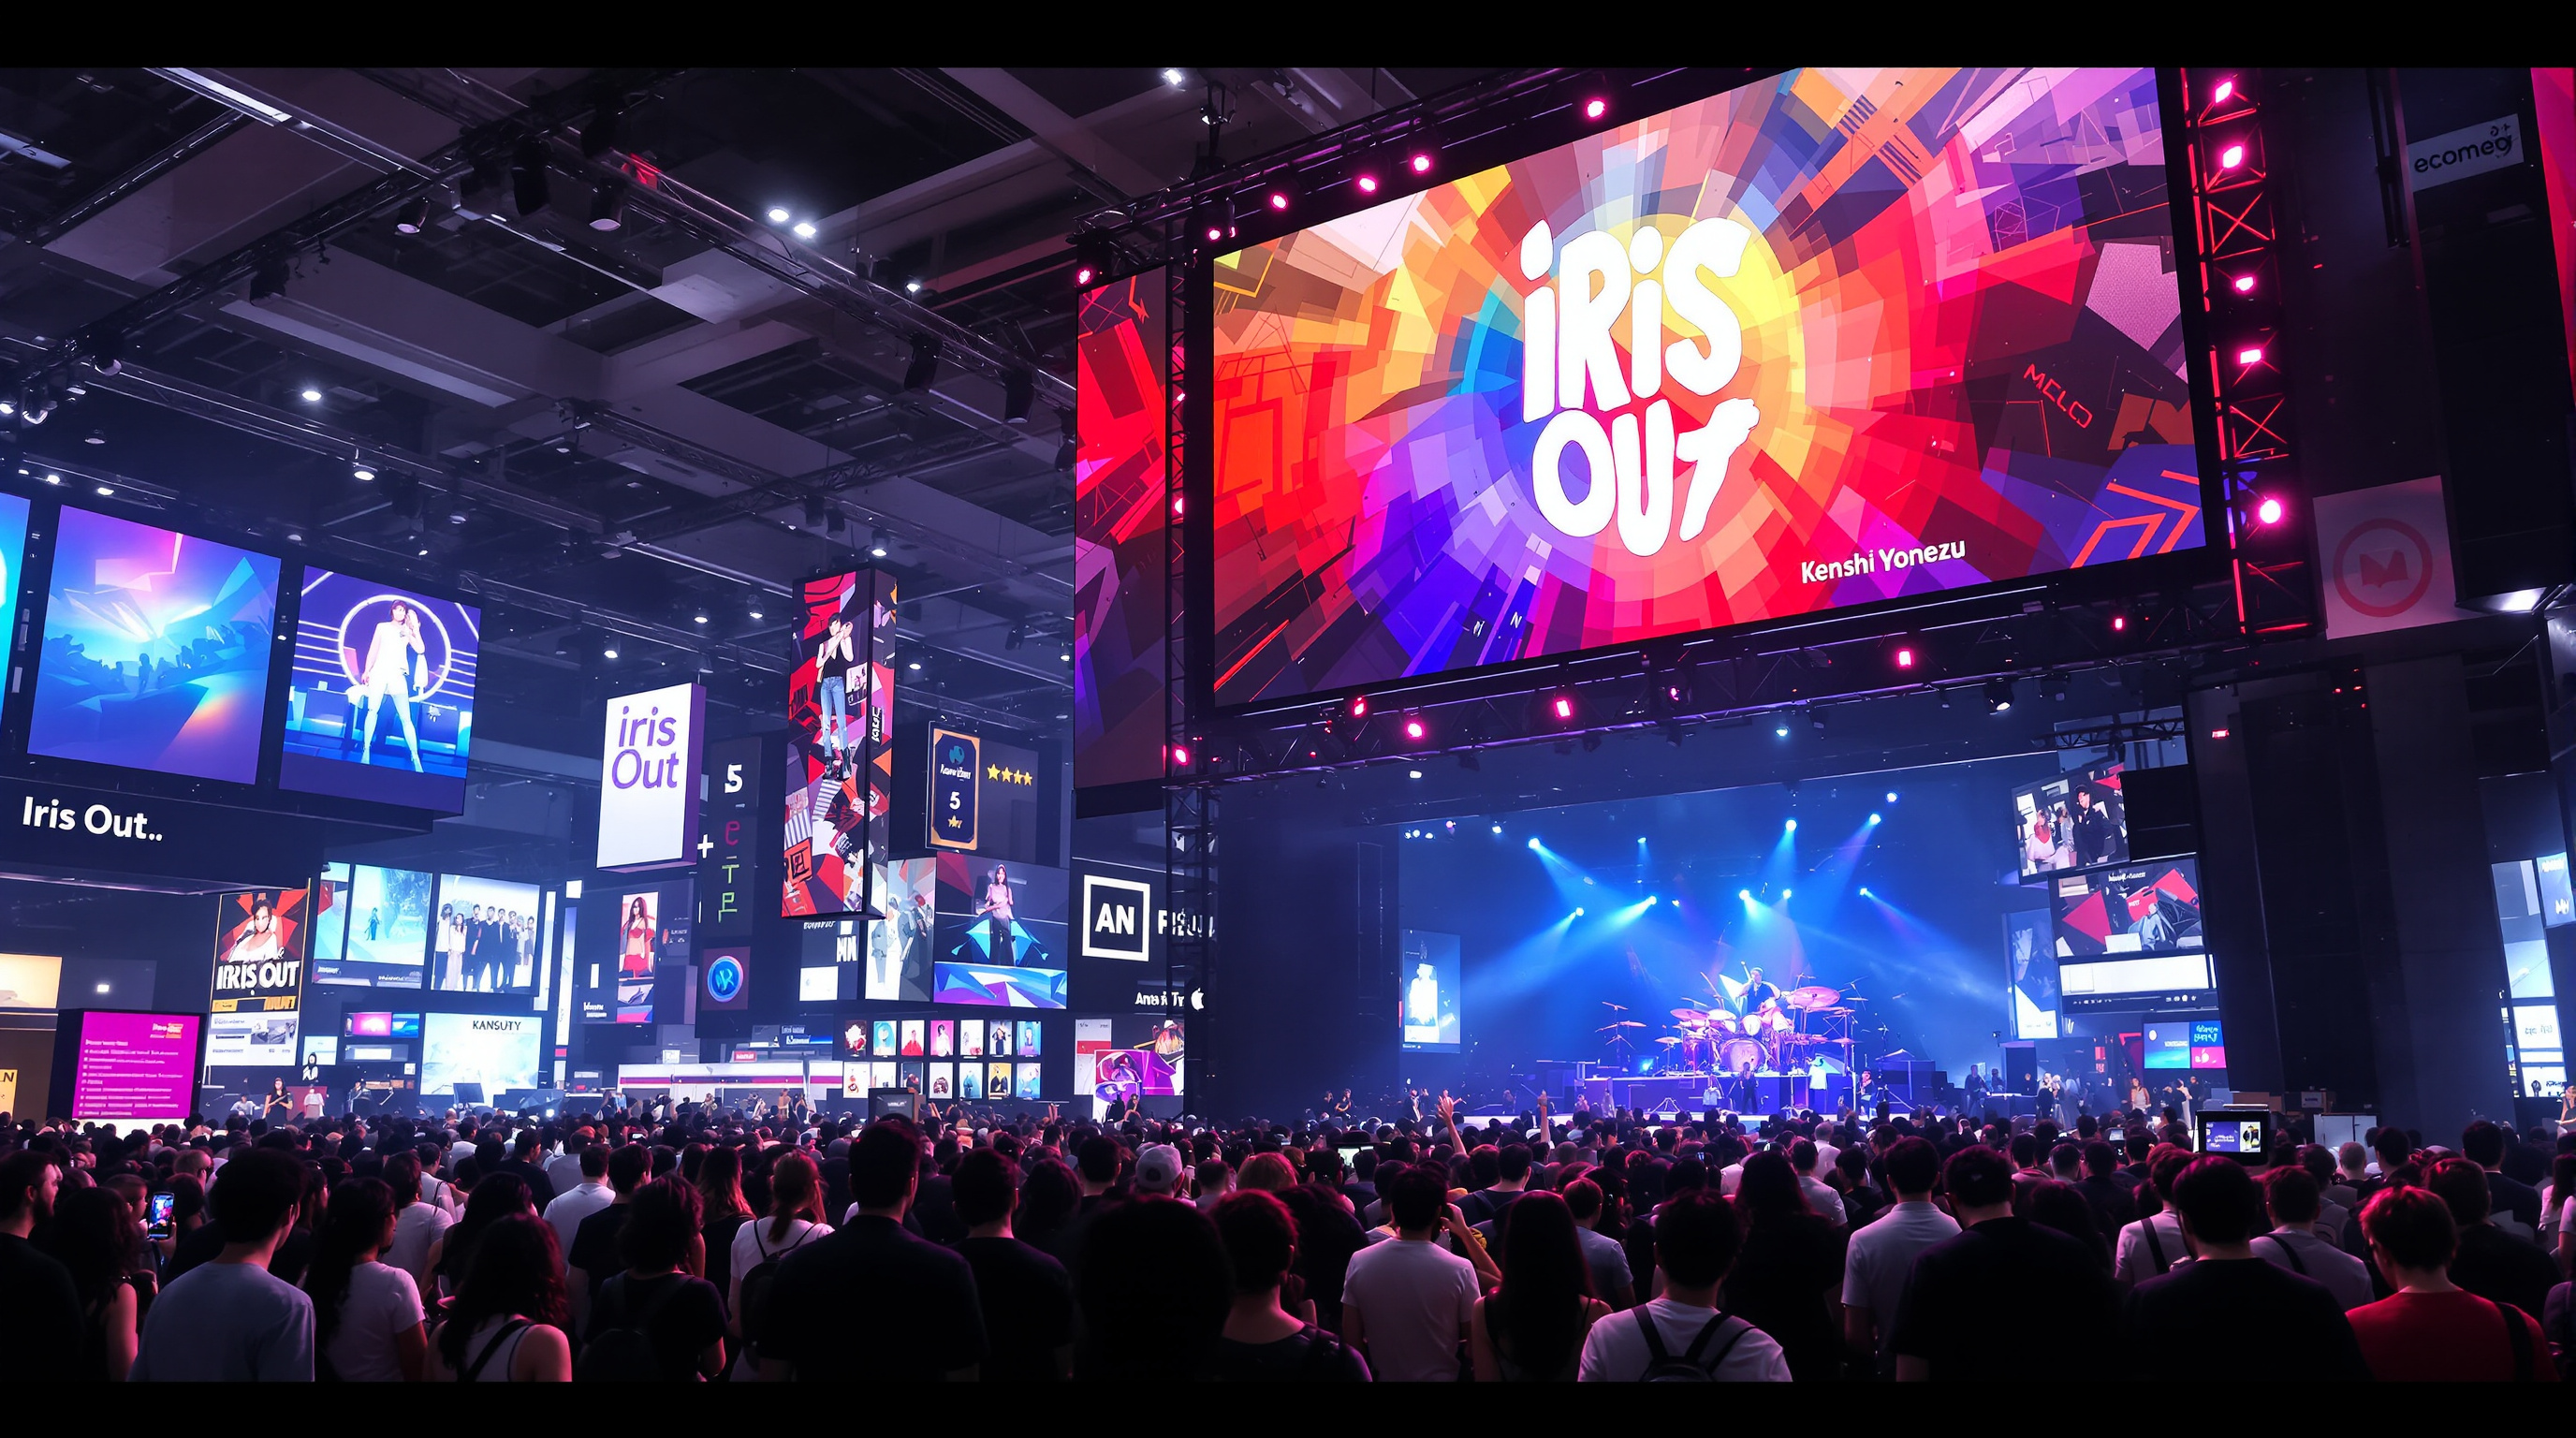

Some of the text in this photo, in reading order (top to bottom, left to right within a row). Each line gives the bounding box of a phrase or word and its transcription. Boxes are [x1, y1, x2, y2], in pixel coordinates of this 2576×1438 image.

[1801, 539, 1966, 584] Kenshi Yonezu
[611, 748, 680, 789] Out
[724, 764, 743, 794] 5
[22, 796, 76, 831] Iris
[949, 791, 961, 810] 5
[1094, 902, 1135, 935] AN
[258, 961, 300, 989] OUT
